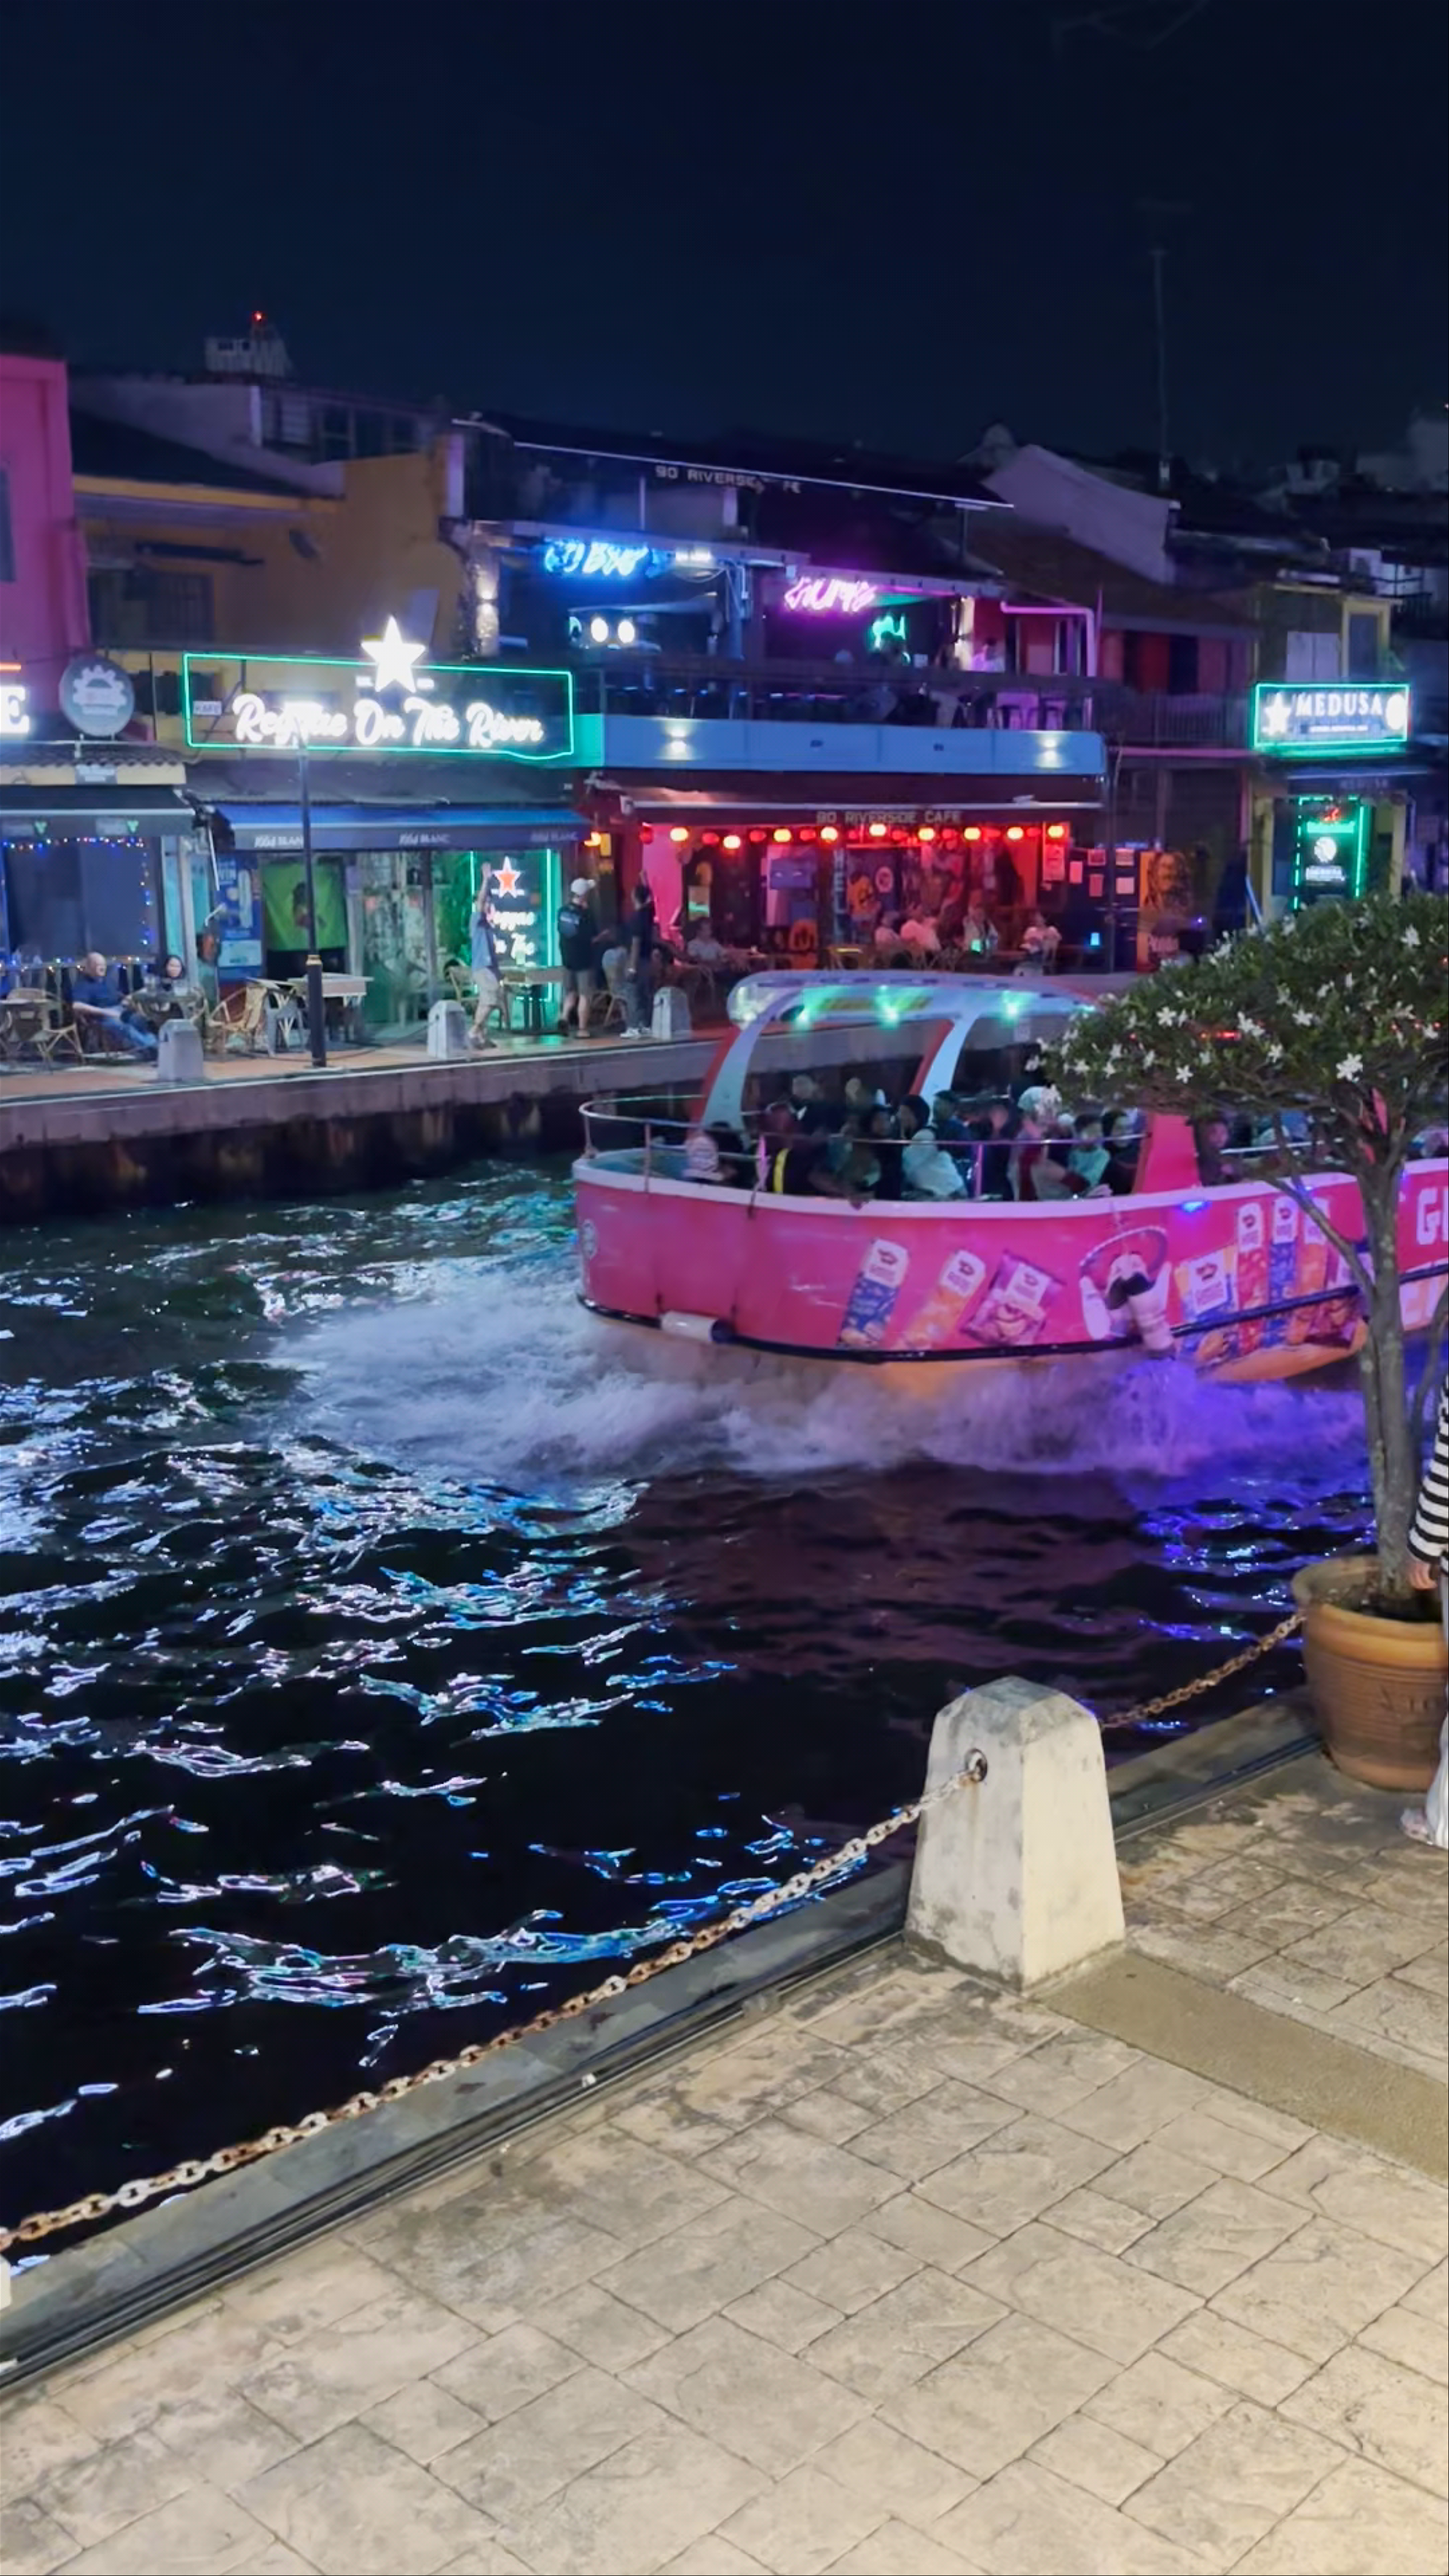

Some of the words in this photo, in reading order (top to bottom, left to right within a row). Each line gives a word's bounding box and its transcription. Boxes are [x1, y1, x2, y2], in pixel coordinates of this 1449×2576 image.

[655, 465, 678, 479] 90
[1295, 691, 1383, 717] MEDUSA
[353, 699, 405, 745] On
[403, 697, 460, 746] The
[466, 702, 543, 747] River
[278, 836, 303, 847] BLAN
